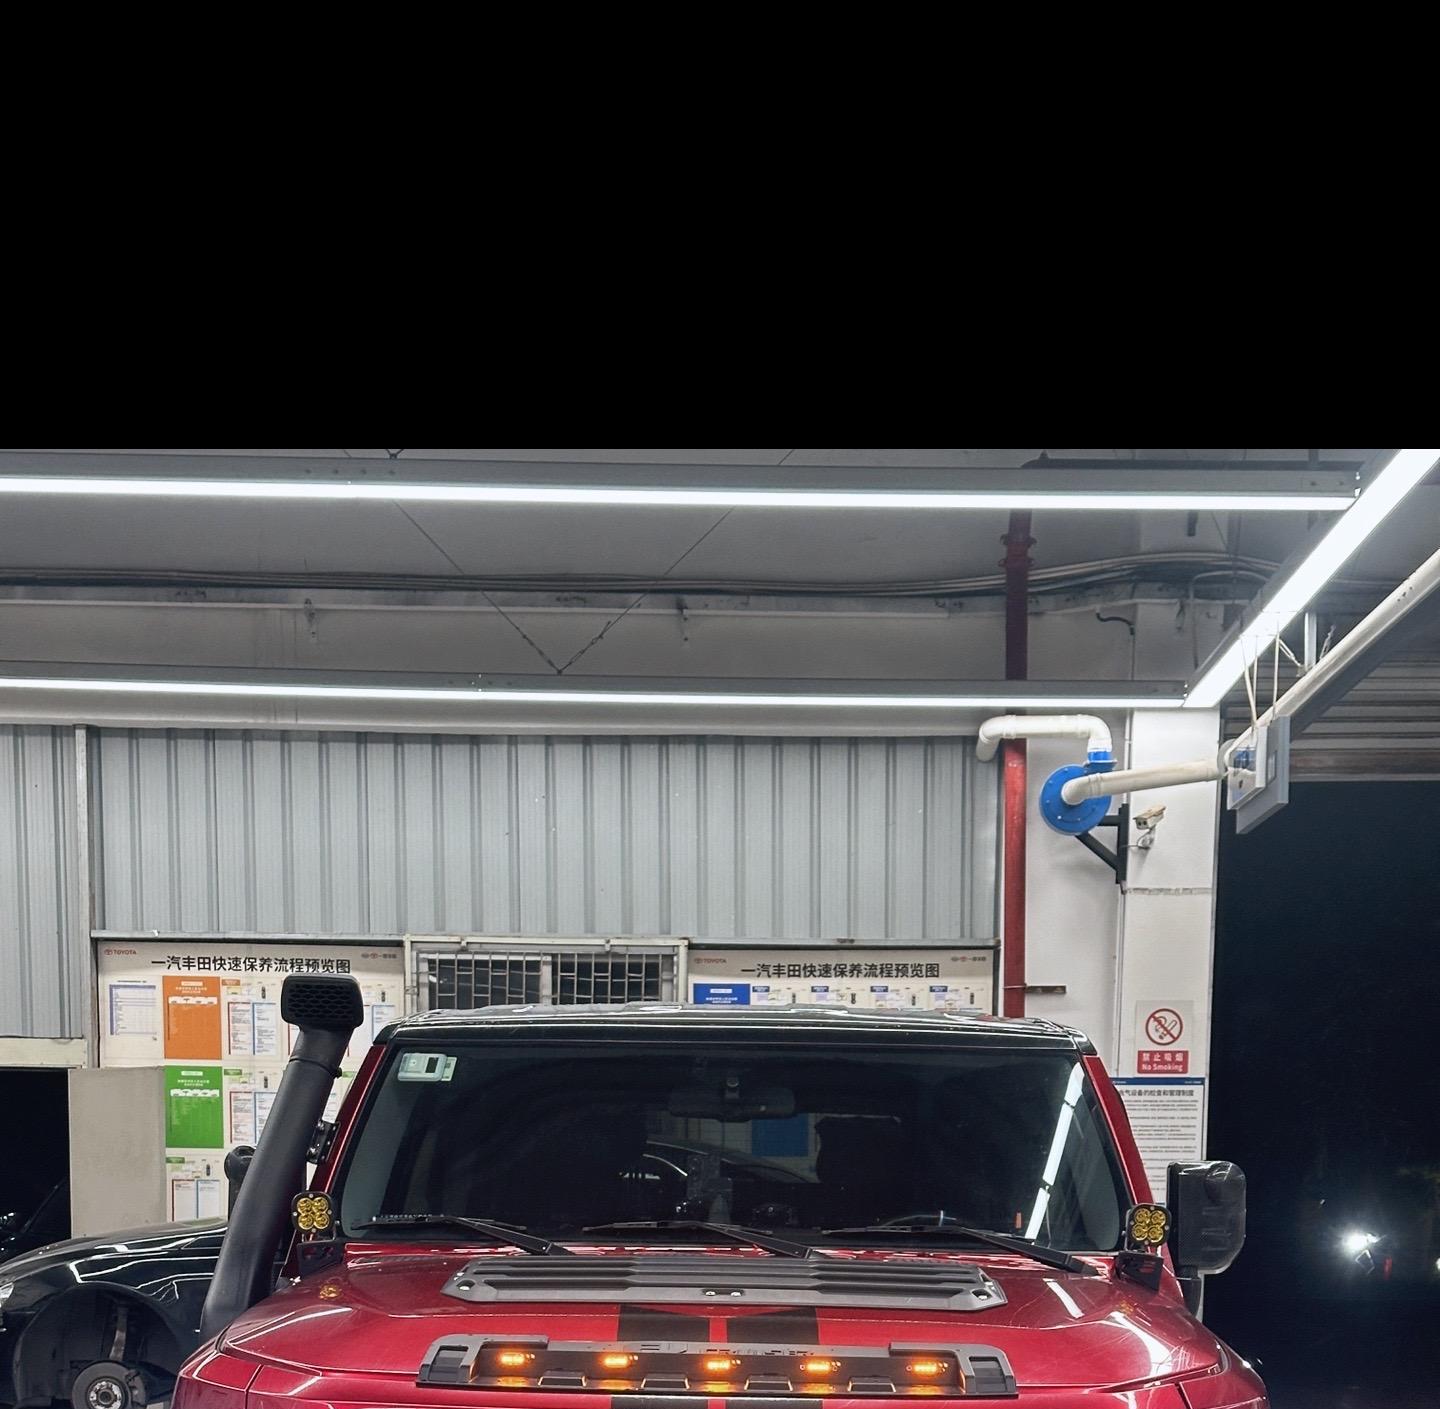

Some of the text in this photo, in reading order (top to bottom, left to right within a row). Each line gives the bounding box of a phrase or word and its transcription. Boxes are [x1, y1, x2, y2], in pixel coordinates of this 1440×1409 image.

[151, 955, 351, 974] 一汽丰田快速保养流程预览图
[741, 963, 940, 978] 一汽丰田快速保养流程预览图
[1152, 1063, 1184, 1072] Smoking
